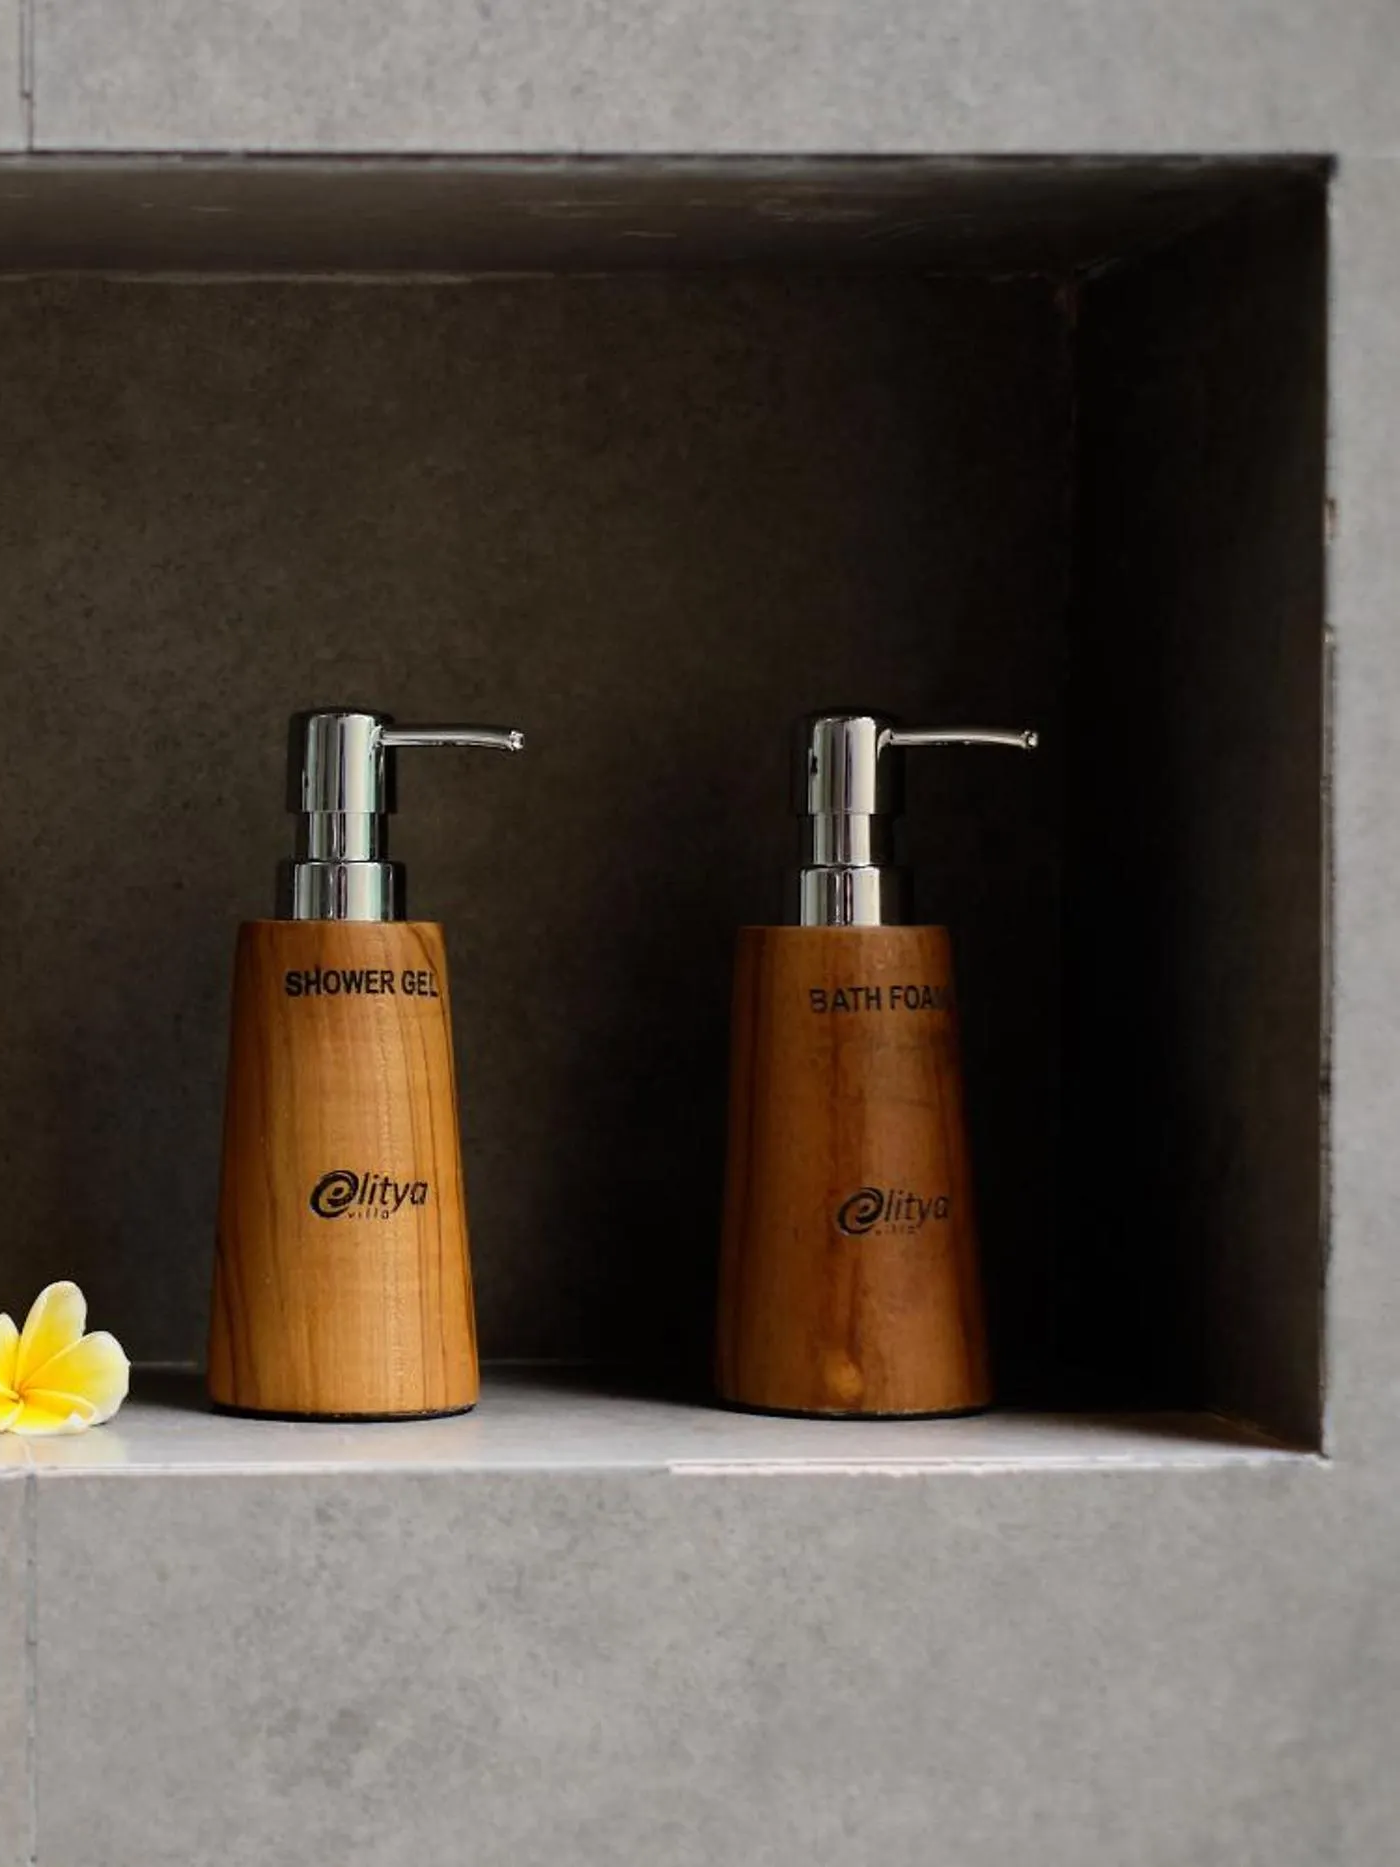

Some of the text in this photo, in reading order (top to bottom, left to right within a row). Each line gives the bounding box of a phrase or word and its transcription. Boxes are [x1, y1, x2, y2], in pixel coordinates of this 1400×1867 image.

[285, 967, 438, 997] SHOWER GEL
[809, 985, 950, 1013] BATH FOA
